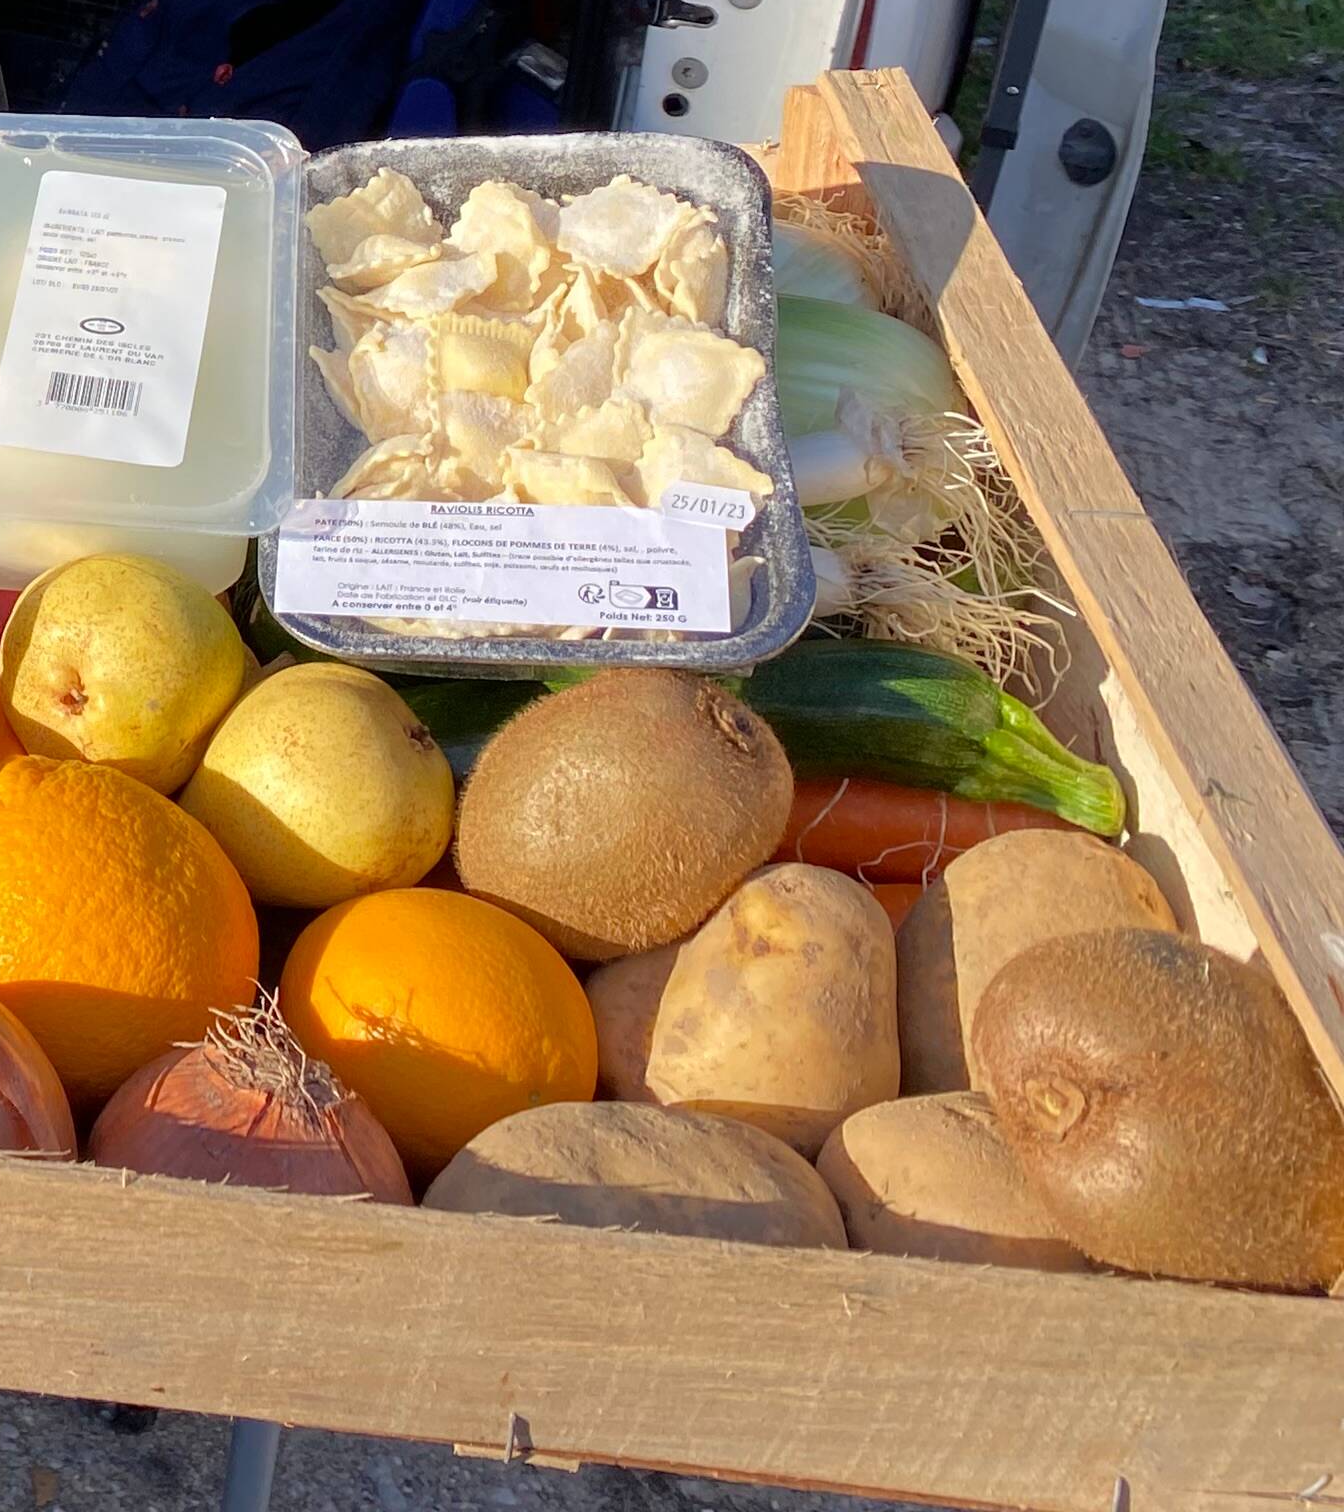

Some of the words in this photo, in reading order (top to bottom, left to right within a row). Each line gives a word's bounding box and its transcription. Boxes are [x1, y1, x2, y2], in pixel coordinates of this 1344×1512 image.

[430, 504, 483, 515] RAVIOLIS
[486, 506, 535, 517] RICOTTA
[671, 494, 746, 520] 25/01/23
[371, 520, 407, 528] Semoule
[510, 541, 552, 550] POMMES
[553, 542, 566, 550] DE
[569, 543, 597, 551] TERRE
[400, 584, 430, 593] France
[331, 599, 339, 608] A
[342, 601, 392, 609] conserver
[395, 602, 422, 611] entre
[434, 604, 444, 612] et
[599, 611, 629, 620] Poids
[656, 614, 675, 622] 250
